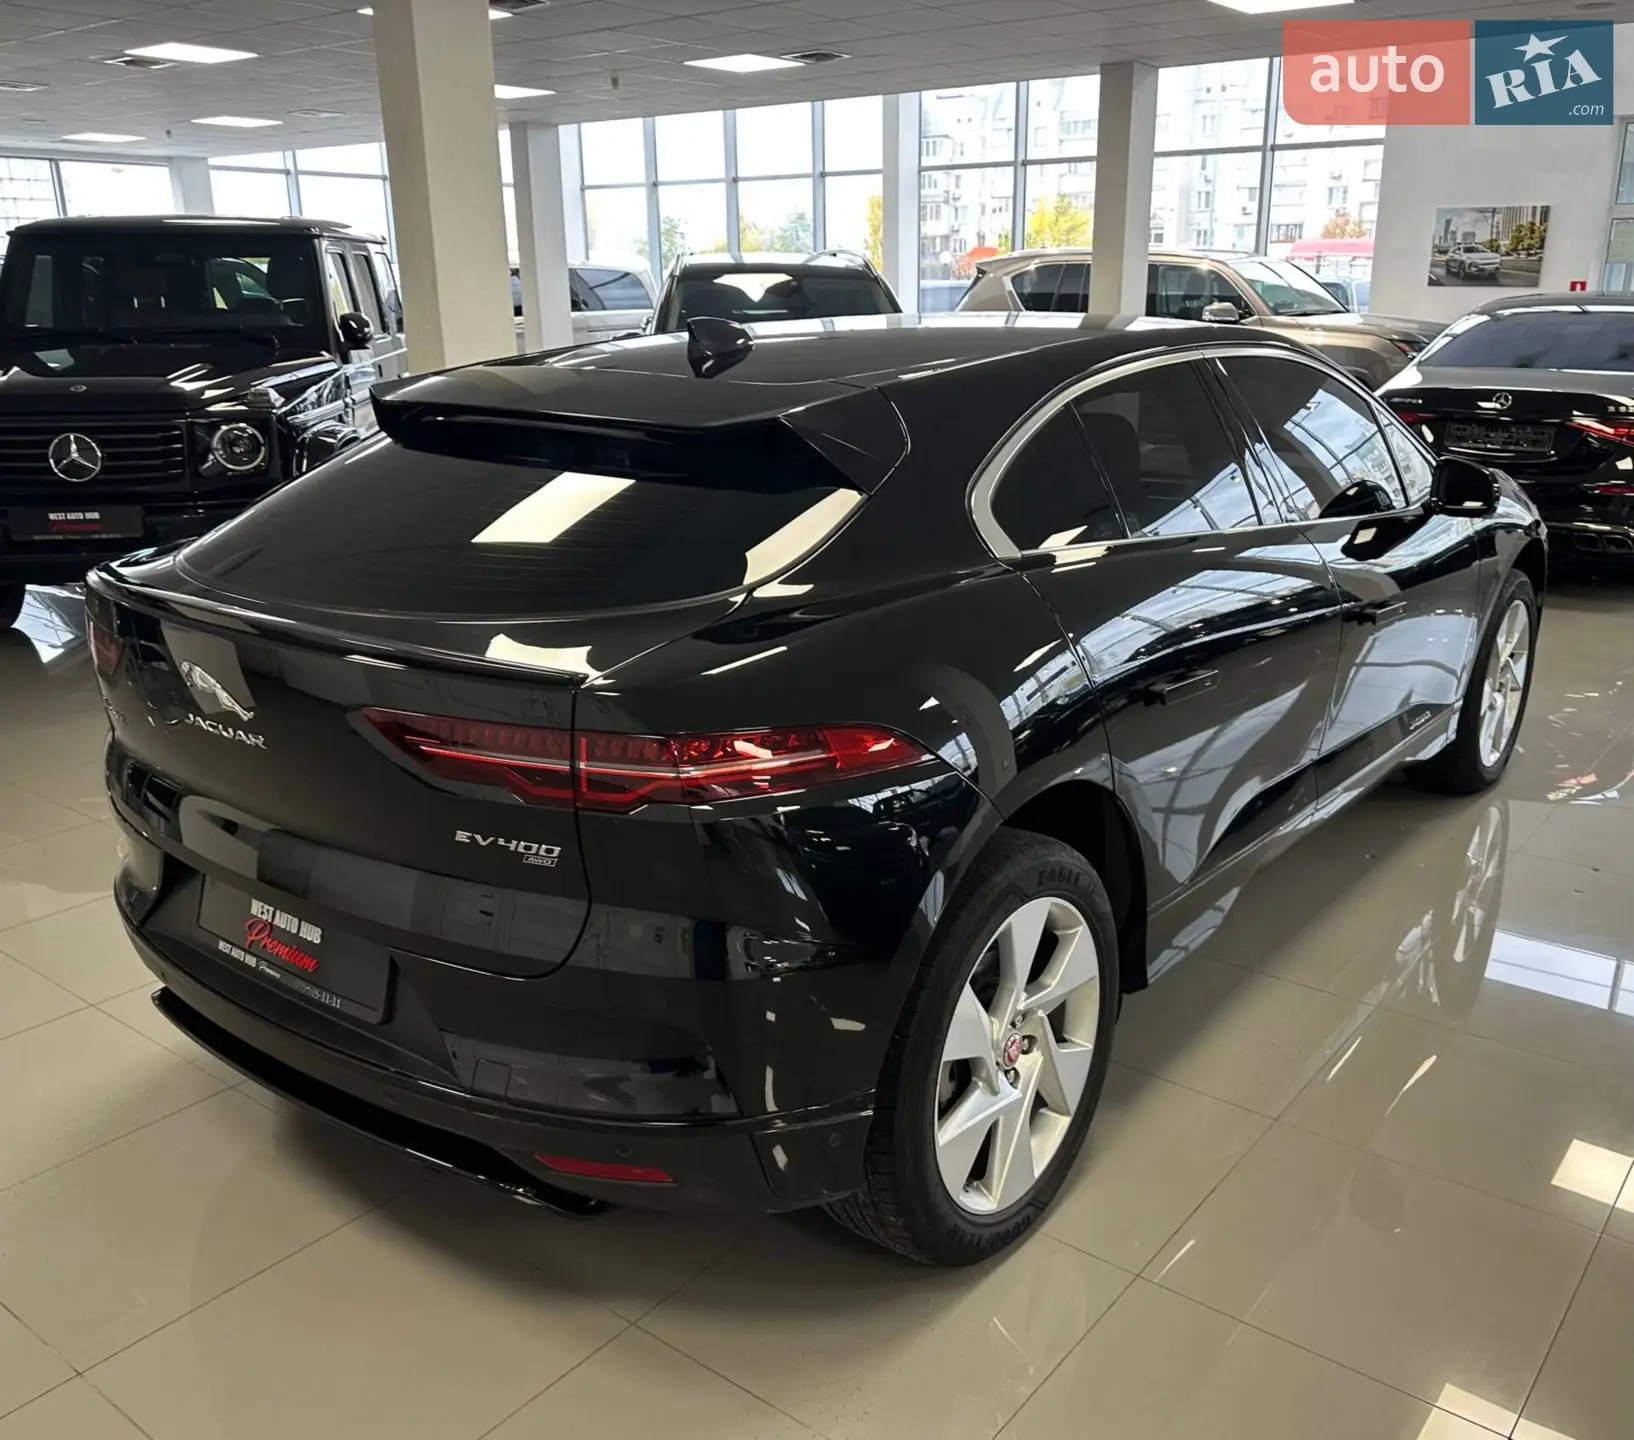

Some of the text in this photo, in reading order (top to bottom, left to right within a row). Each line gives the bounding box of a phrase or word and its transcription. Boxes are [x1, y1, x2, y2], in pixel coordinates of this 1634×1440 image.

[184, 712, 268, 751] JAGUAR
[454, 830, 561, 857] EV400
[251, 898, 322, 944] WEST AUTO HUB
[218, 940, 231, 954] WEST
[231, 947, 245, 961] AUTO
[245, 918, 320, 972] Premium
